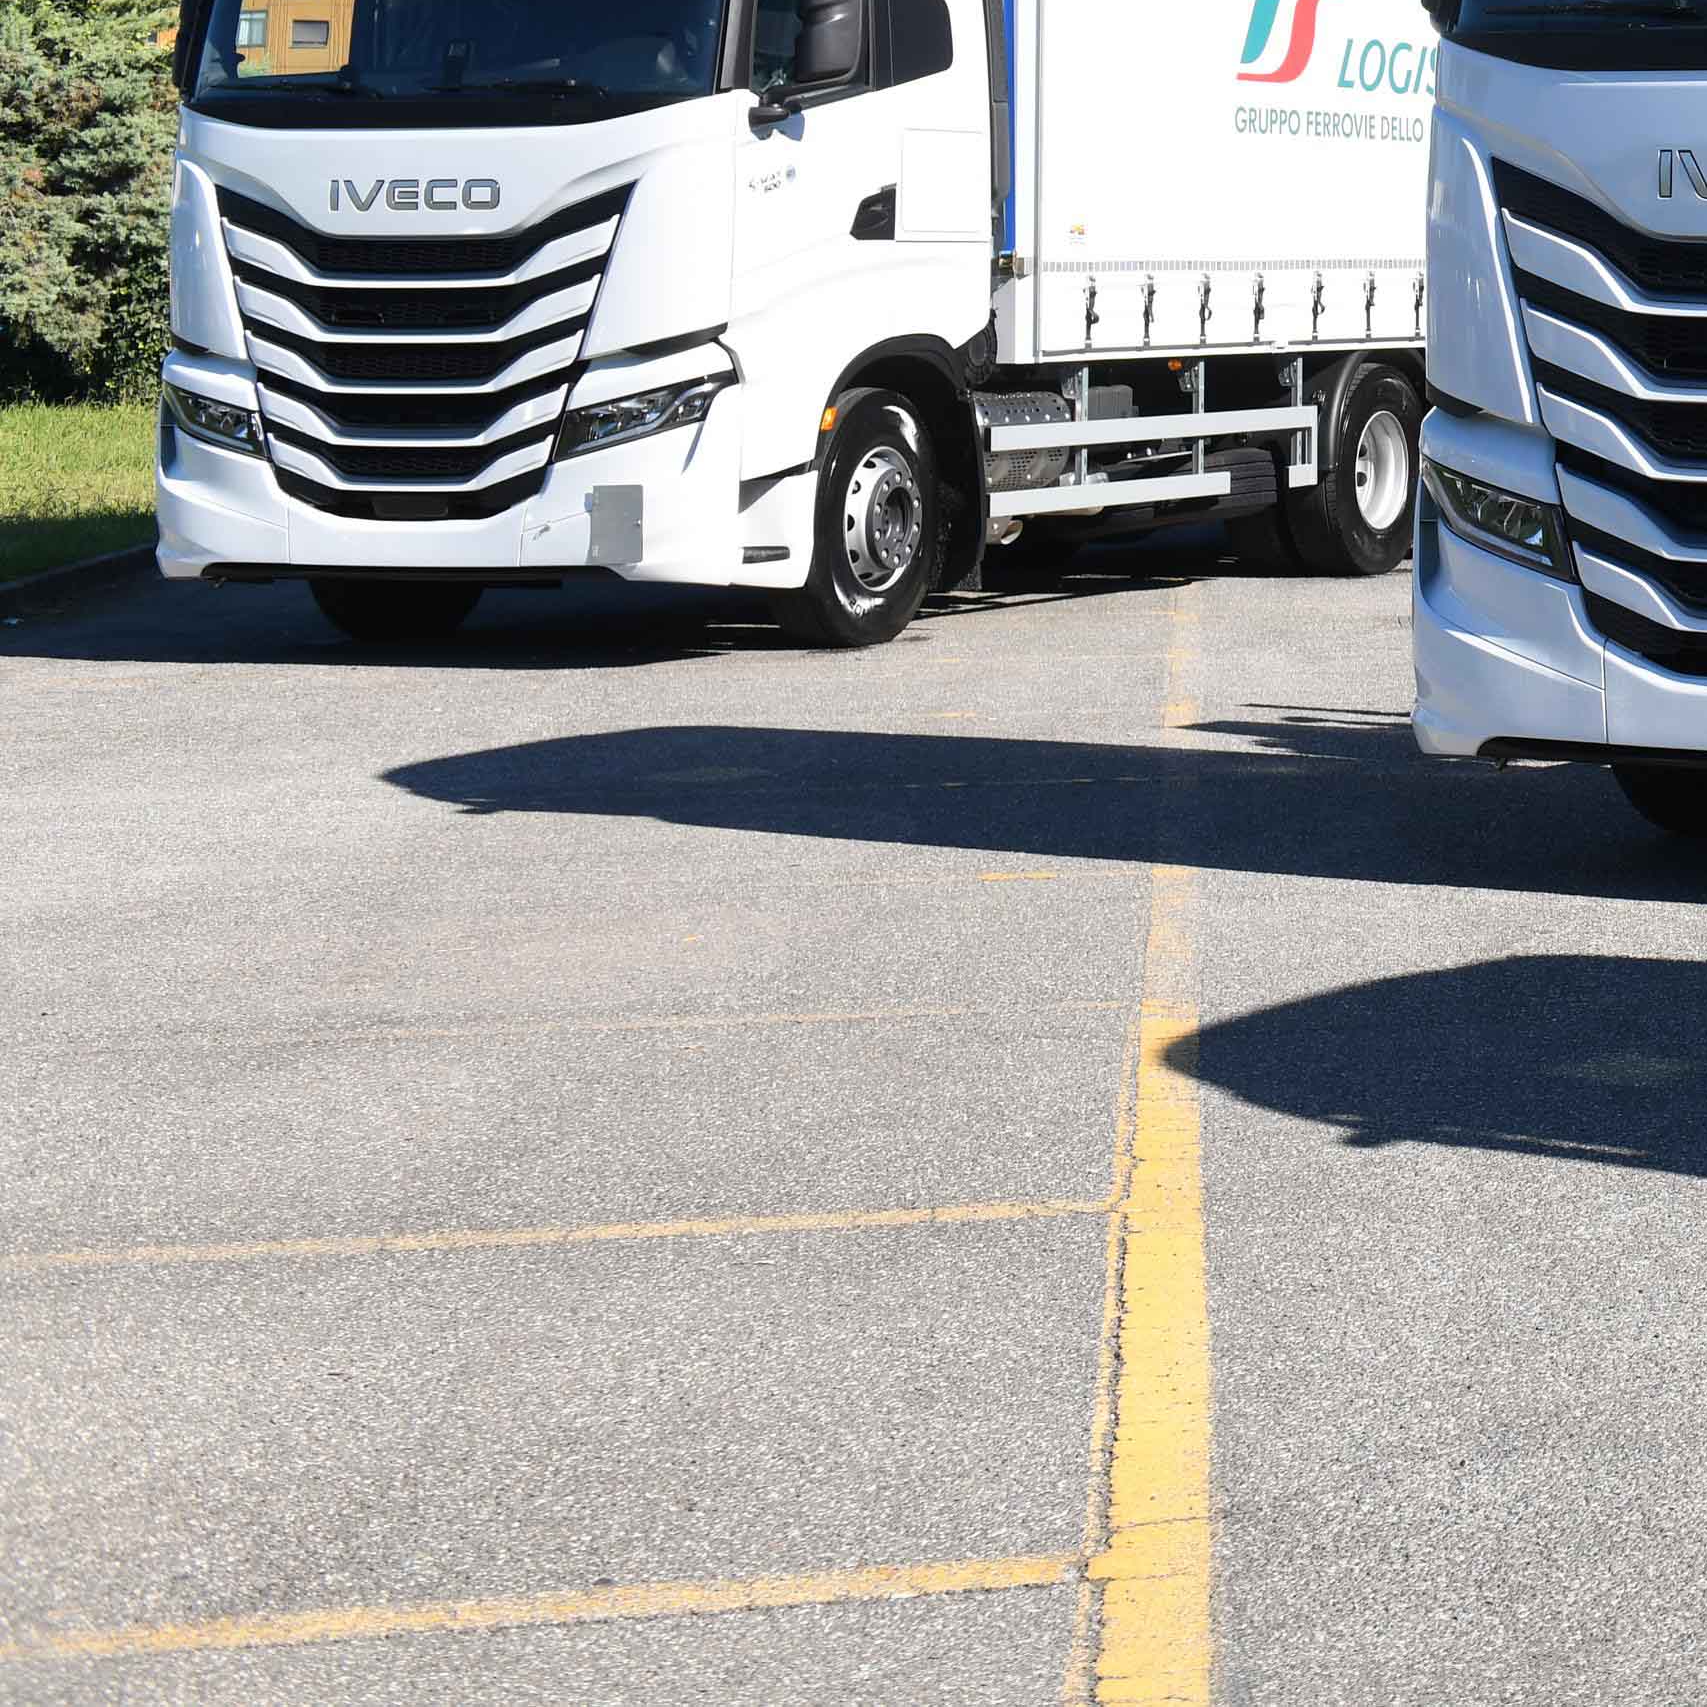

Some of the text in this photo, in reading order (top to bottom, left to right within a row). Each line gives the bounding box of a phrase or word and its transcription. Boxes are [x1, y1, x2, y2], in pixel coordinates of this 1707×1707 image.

[1234, 107, 1424, 143] GRUPPO FERROVIE DELLO
[329, 178, 501, 212] IVECO
